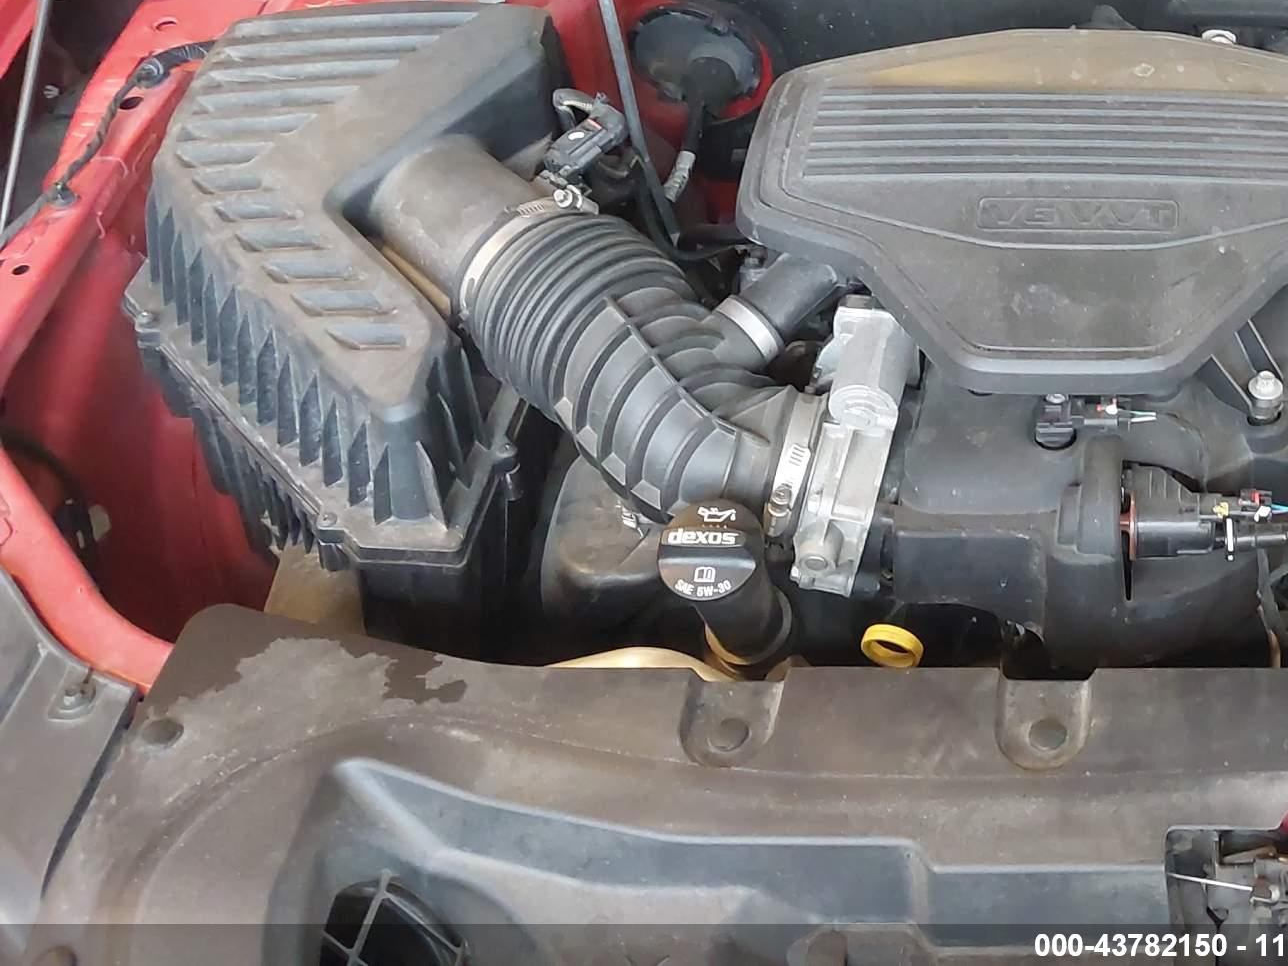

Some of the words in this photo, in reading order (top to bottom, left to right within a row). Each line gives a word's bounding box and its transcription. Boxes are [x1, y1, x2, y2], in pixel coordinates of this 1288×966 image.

[668, 527, 740, 545] dexos
[675, 579, 694, 595] SAE
[696, 579, 732, 597] 5W-30
